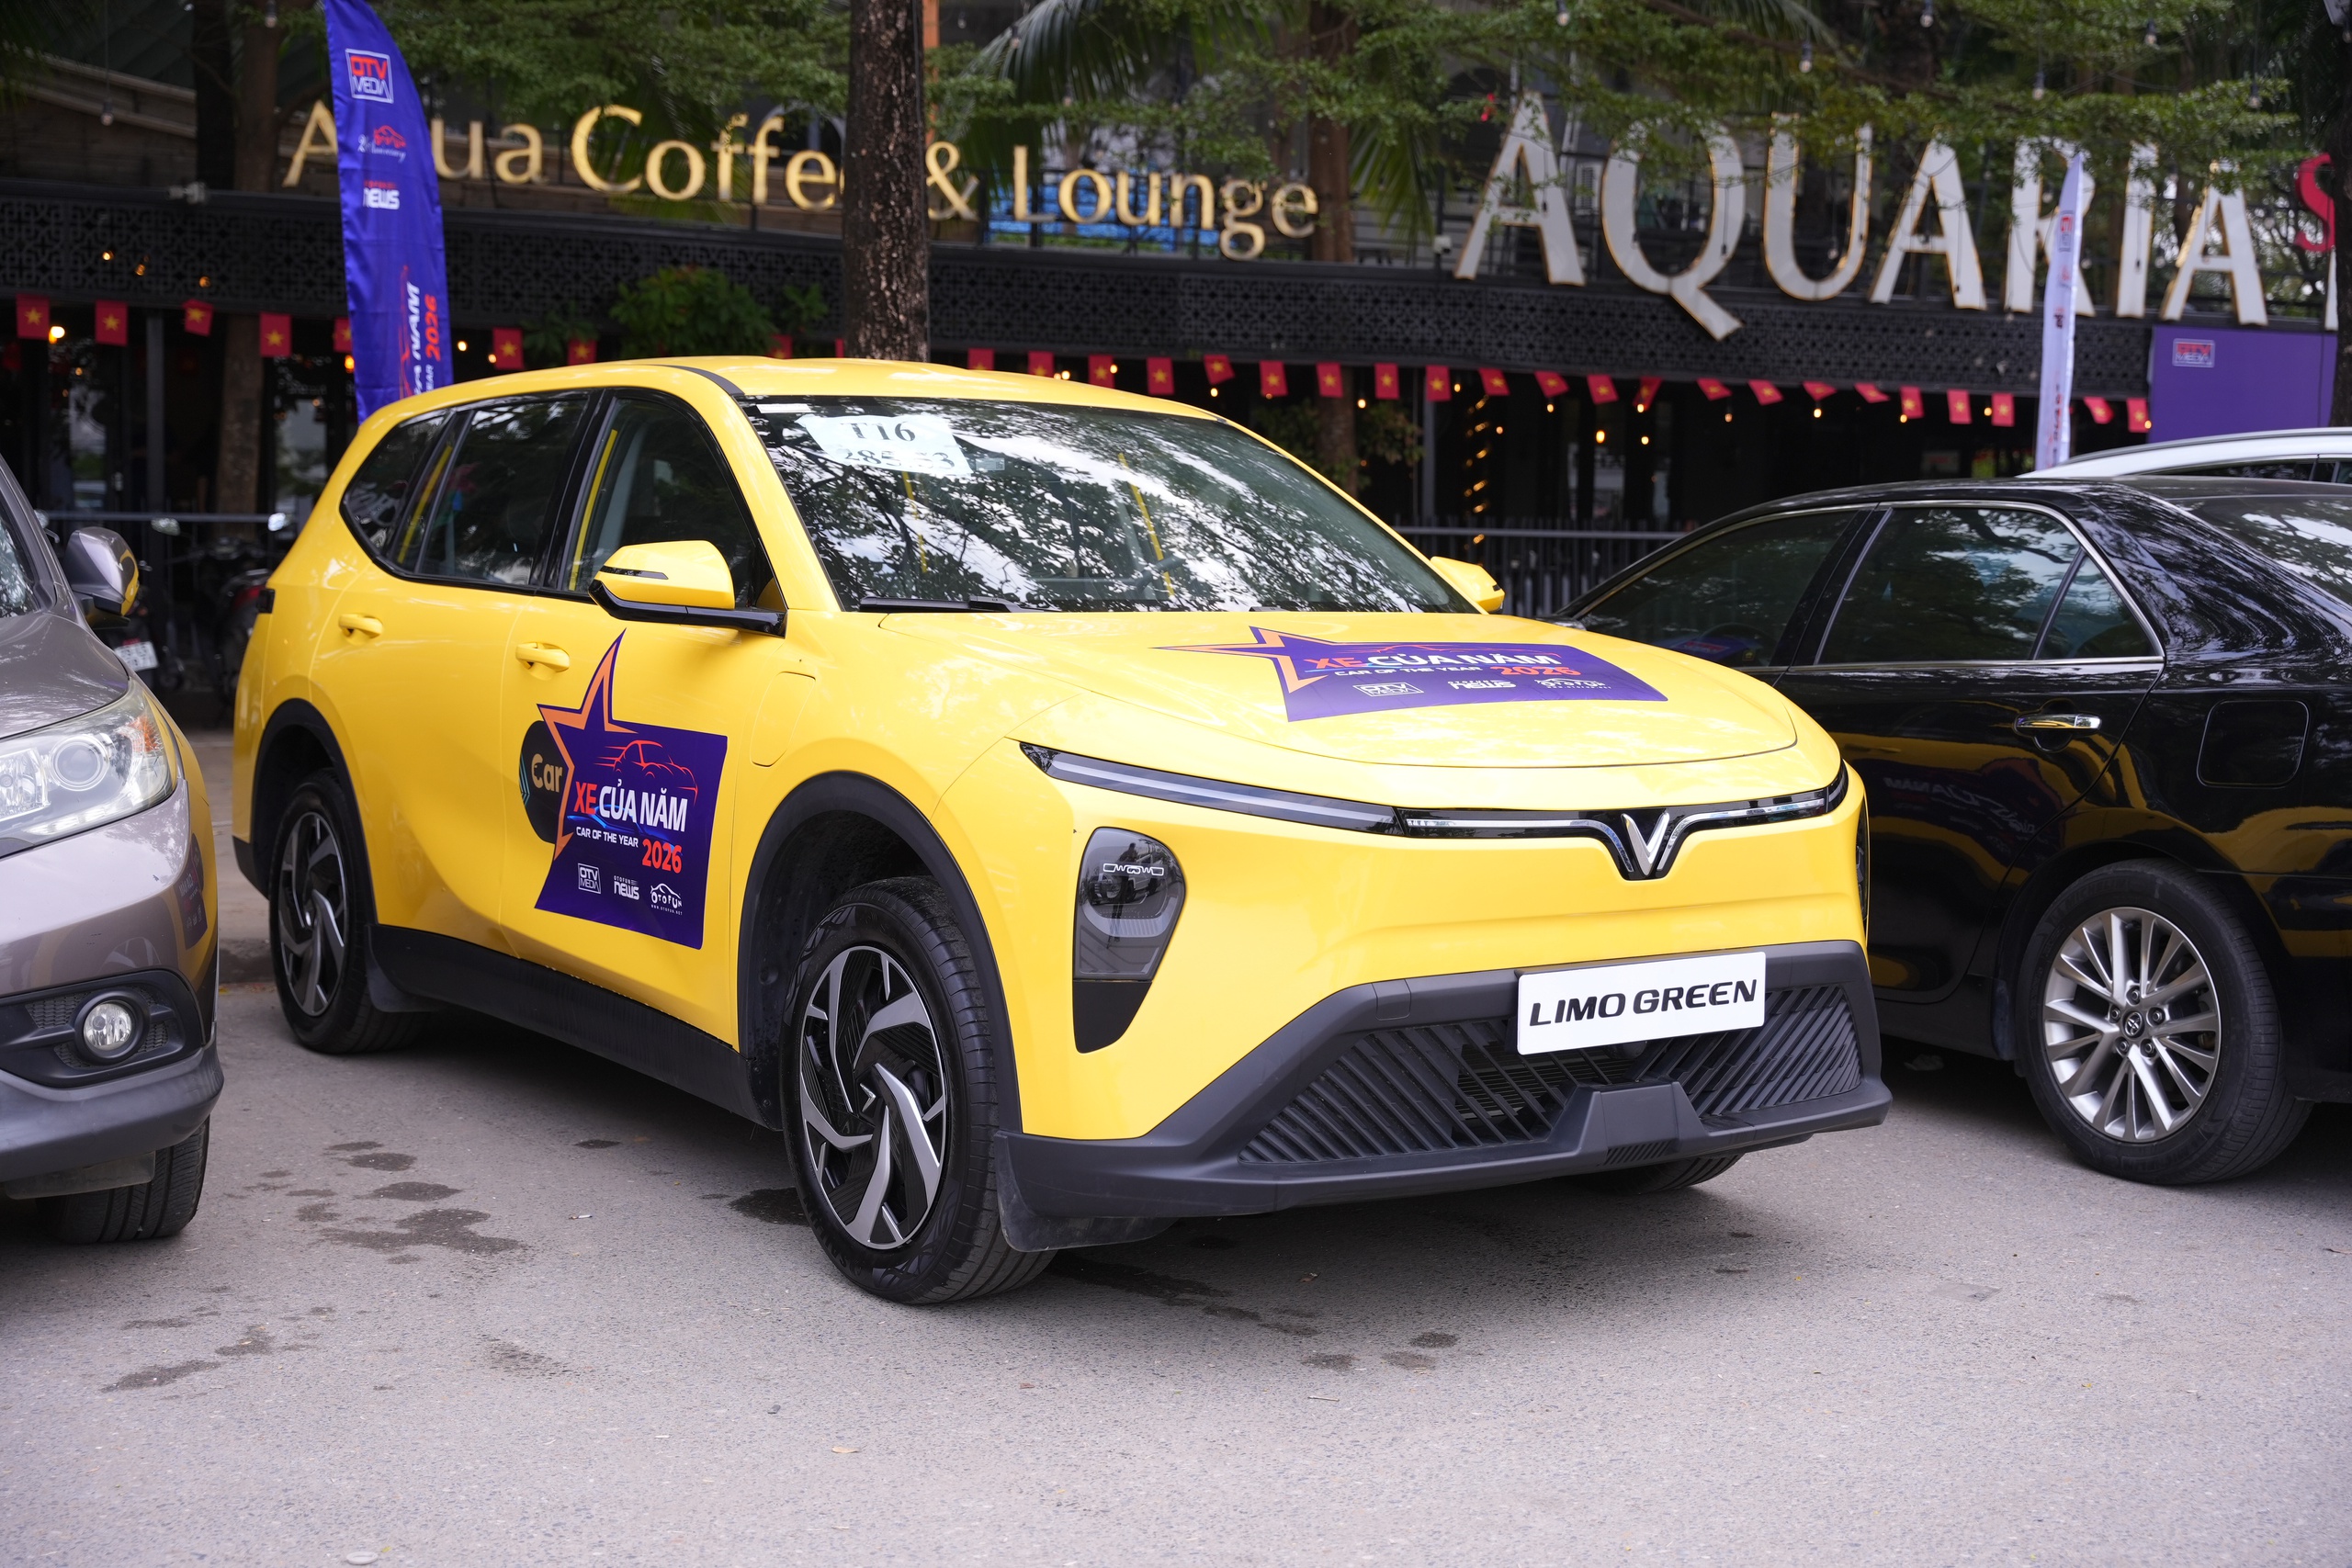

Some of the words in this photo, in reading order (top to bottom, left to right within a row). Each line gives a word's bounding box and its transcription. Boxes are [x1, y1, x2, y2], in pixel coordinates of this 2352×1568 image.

[350, 55, 388, 79] OTV
[353, 75, 392, 99] MEDIA
[283, 99, 548, 187] Aua
[571, 104, 845, 211] Coffe
[925, 141, 979, 222] &
[1013, 144, 1319, 261] Lounge
[424, 293, 441, 362] 2026
[840, 421, 916, 442] T16
[1303, 657, 1363, 670] XE
[1367, 653, 1464, 666] CỦA
[1489, 666, 1582, 676] 2026
[531, 753, 563, 793] Car
[572, 781, 598, 816] XE
[599, 778, 638, 824] CỦA
[639, 787, 688, 832] NĂM
[576, 826, 592, 839] CAR
[592, 829, 603, 840] OF
[603, 830, 617, 844] THE
[618, 834, 639, 849] YEAR
[641, 838, 683, 874] 2026
[580, 866, 598, 881] OTV
[580, 877, 600, 891] MEDIA
[613, 874, 631, 886] OTOFUN
[650, 891, 683, 909] OTOFUN
[1529, 992, 1626, 1027] LIMO
[1633, 978, 1758, 1015] GREEN
